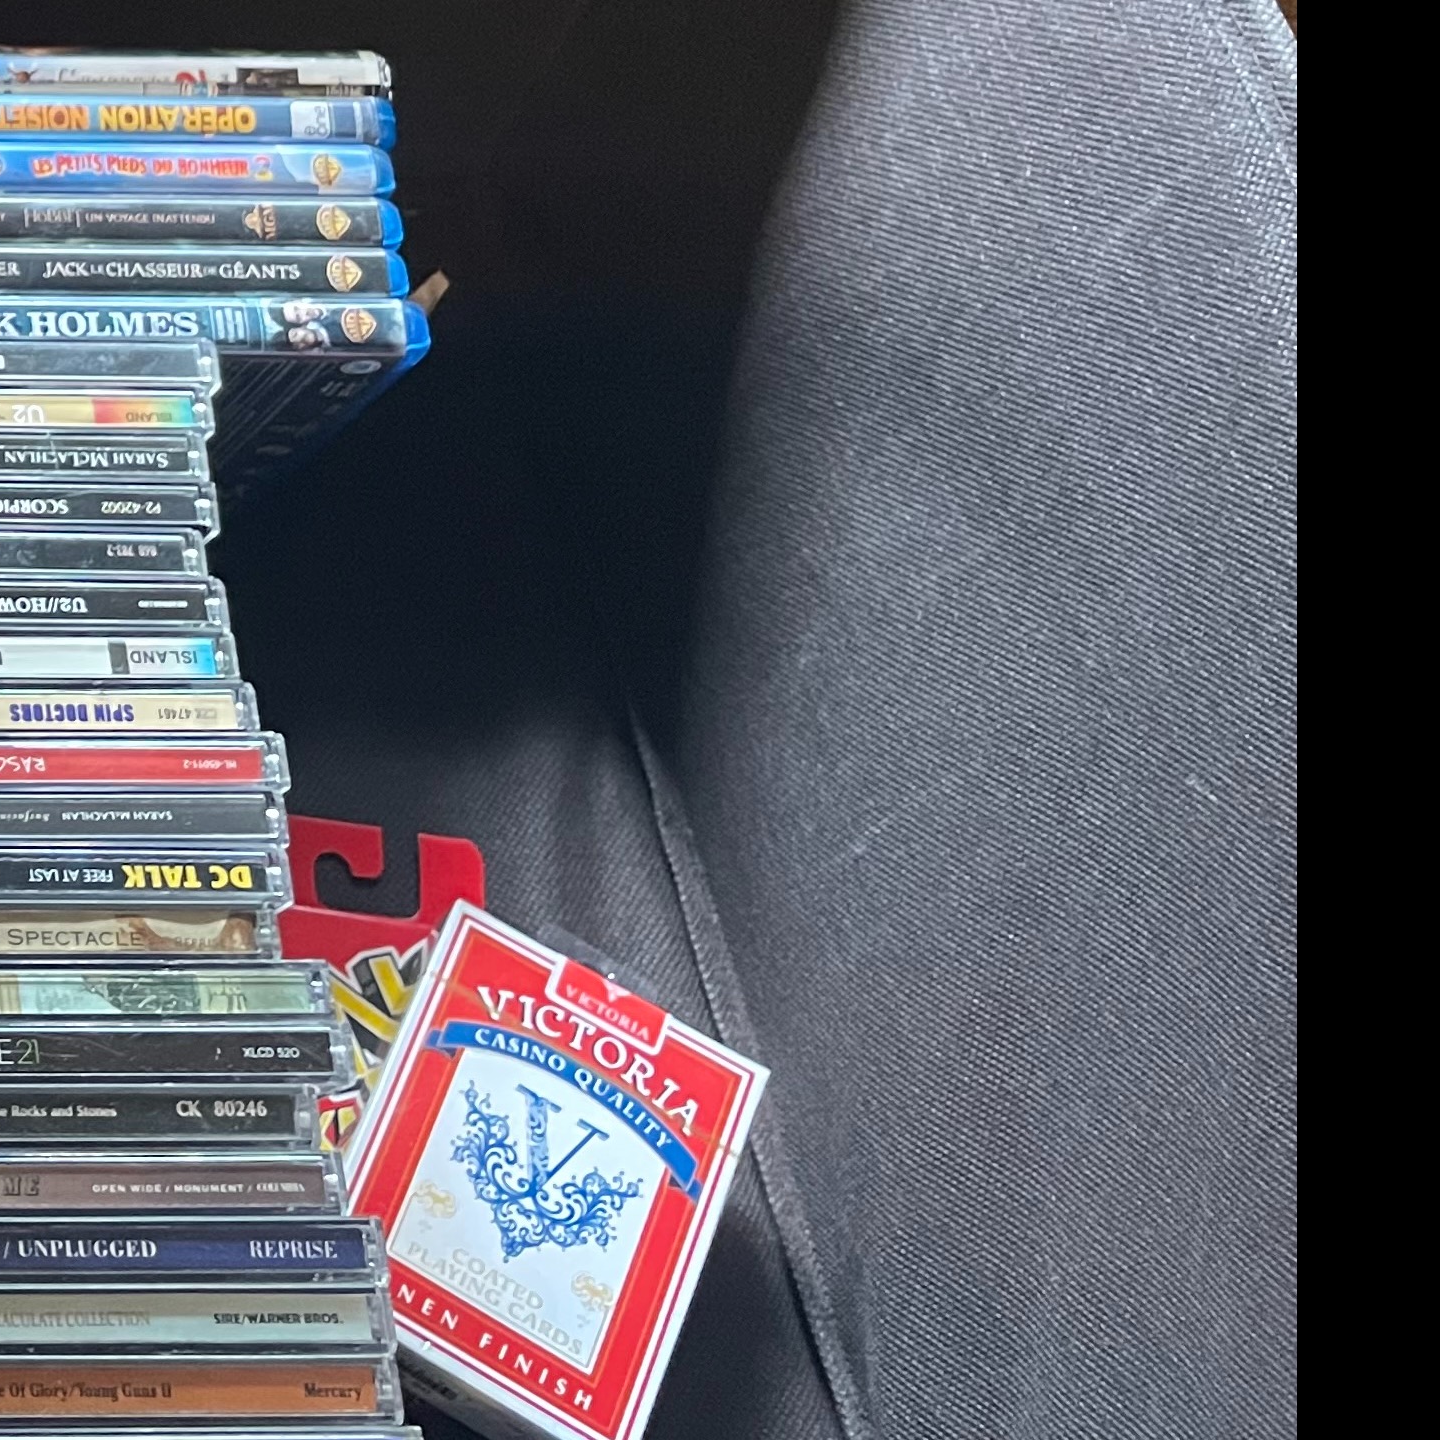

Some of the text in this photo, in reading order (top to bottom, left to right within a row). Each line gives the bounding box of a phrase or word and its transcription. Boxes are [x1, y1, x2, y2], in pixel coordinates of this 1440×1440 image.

[99, 104, 257, 137] OPÉRATION
[104, 212, 216, 224] VOYAGE INATTENDU
[42, 259, 301, 280] JACK CHASSEUR GÉANTS
[27, 310, 199, 338] HOLMES
[11, 403, 46, 425] U2
[113, 450, 169, 469] SARAH
[129, 650, 198, 665] ISLAND
[9, 703, 89, 722] DOCTORS
[94, 703, 135, 723] SPIN
[133, 811, 173, 821] SARAH
[28, 863, 253, 889] DC TALK FREE AT LAST
[7, 928, 146, 947] SPECTACLE
[561, 981, 651, 1042] VICTORIA
[476, 984, 702, 1136] VICTORIA
[473, 1027, 674, 1152] CASINO QUALITY
[10, 1104, 47, 1118] Rocks
[76, 1105, 118, 1118] Stones
[175, 1100, 203, 1119] CK
[213, 1100, 268, 1118] 80246
[173, 1183, 244, 1194] MONUMENT
[18, 1238, 158, 1259] UNPLUGGED
[248, 1239, 338, 1260] REPRISE
[451, 1245, 545, 1311] COATED
[406, 1241, 586, 1357] PLAYING CARDS
[303, 1312, 345, 1326] BROS.
[478, 1331, 595, 1411] FINISH
[303, 1383, 363, 1402] Mercury
